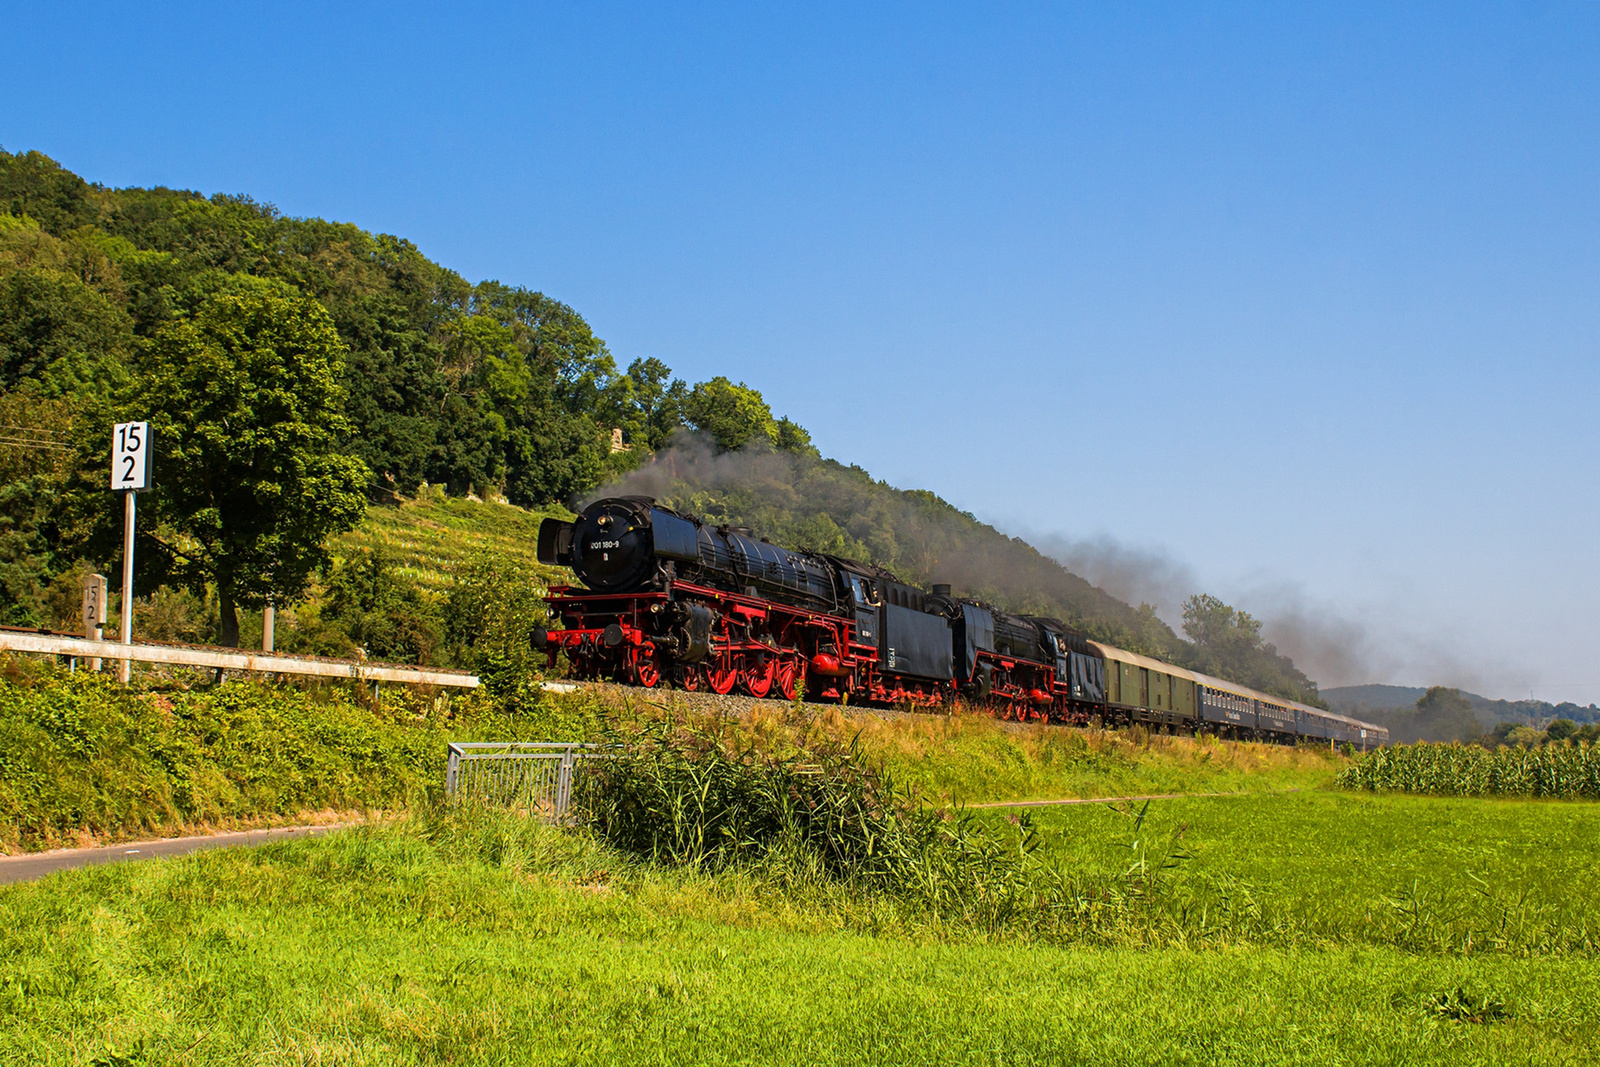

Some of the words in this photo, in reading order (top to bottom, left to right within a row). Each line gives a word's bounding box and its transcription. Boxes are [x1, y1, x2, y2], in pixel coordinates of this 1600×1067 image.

[119, 425, 141, 452] 15
[122, 455, 136, 481] 2
[85, 585, 98, 602] 15
[88, 605, 95, 619] 2
